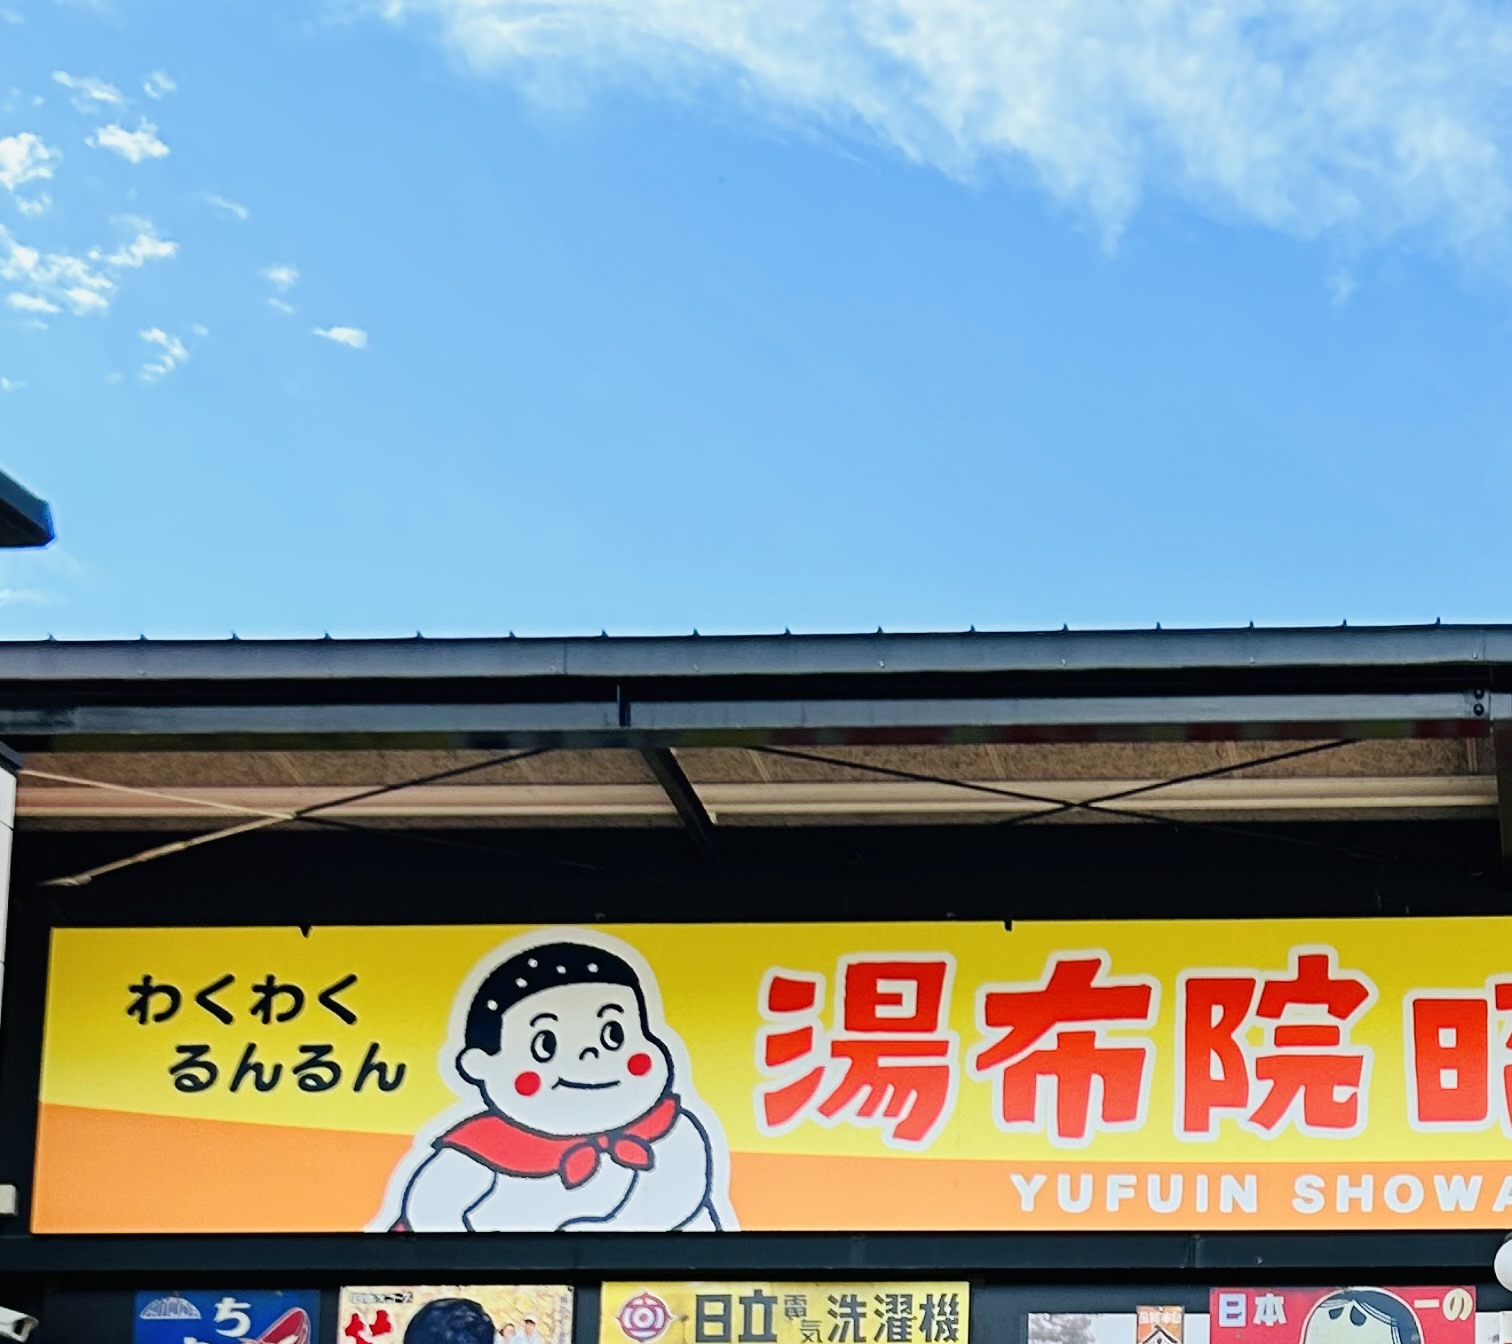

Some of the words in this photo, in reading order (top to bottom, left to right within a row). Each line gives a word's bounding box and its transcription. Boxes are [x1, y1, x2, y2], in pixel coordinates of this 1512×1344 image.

[125, 972, 359, 1027] わくわく
[169, 1041, 407, 1093] るんるん
[1010, 1174, 1260, 1213] YUFUIN
[1218, 1293, 1287, 1327] 日本
[1414, 1289, 1473, 1322] 一の
